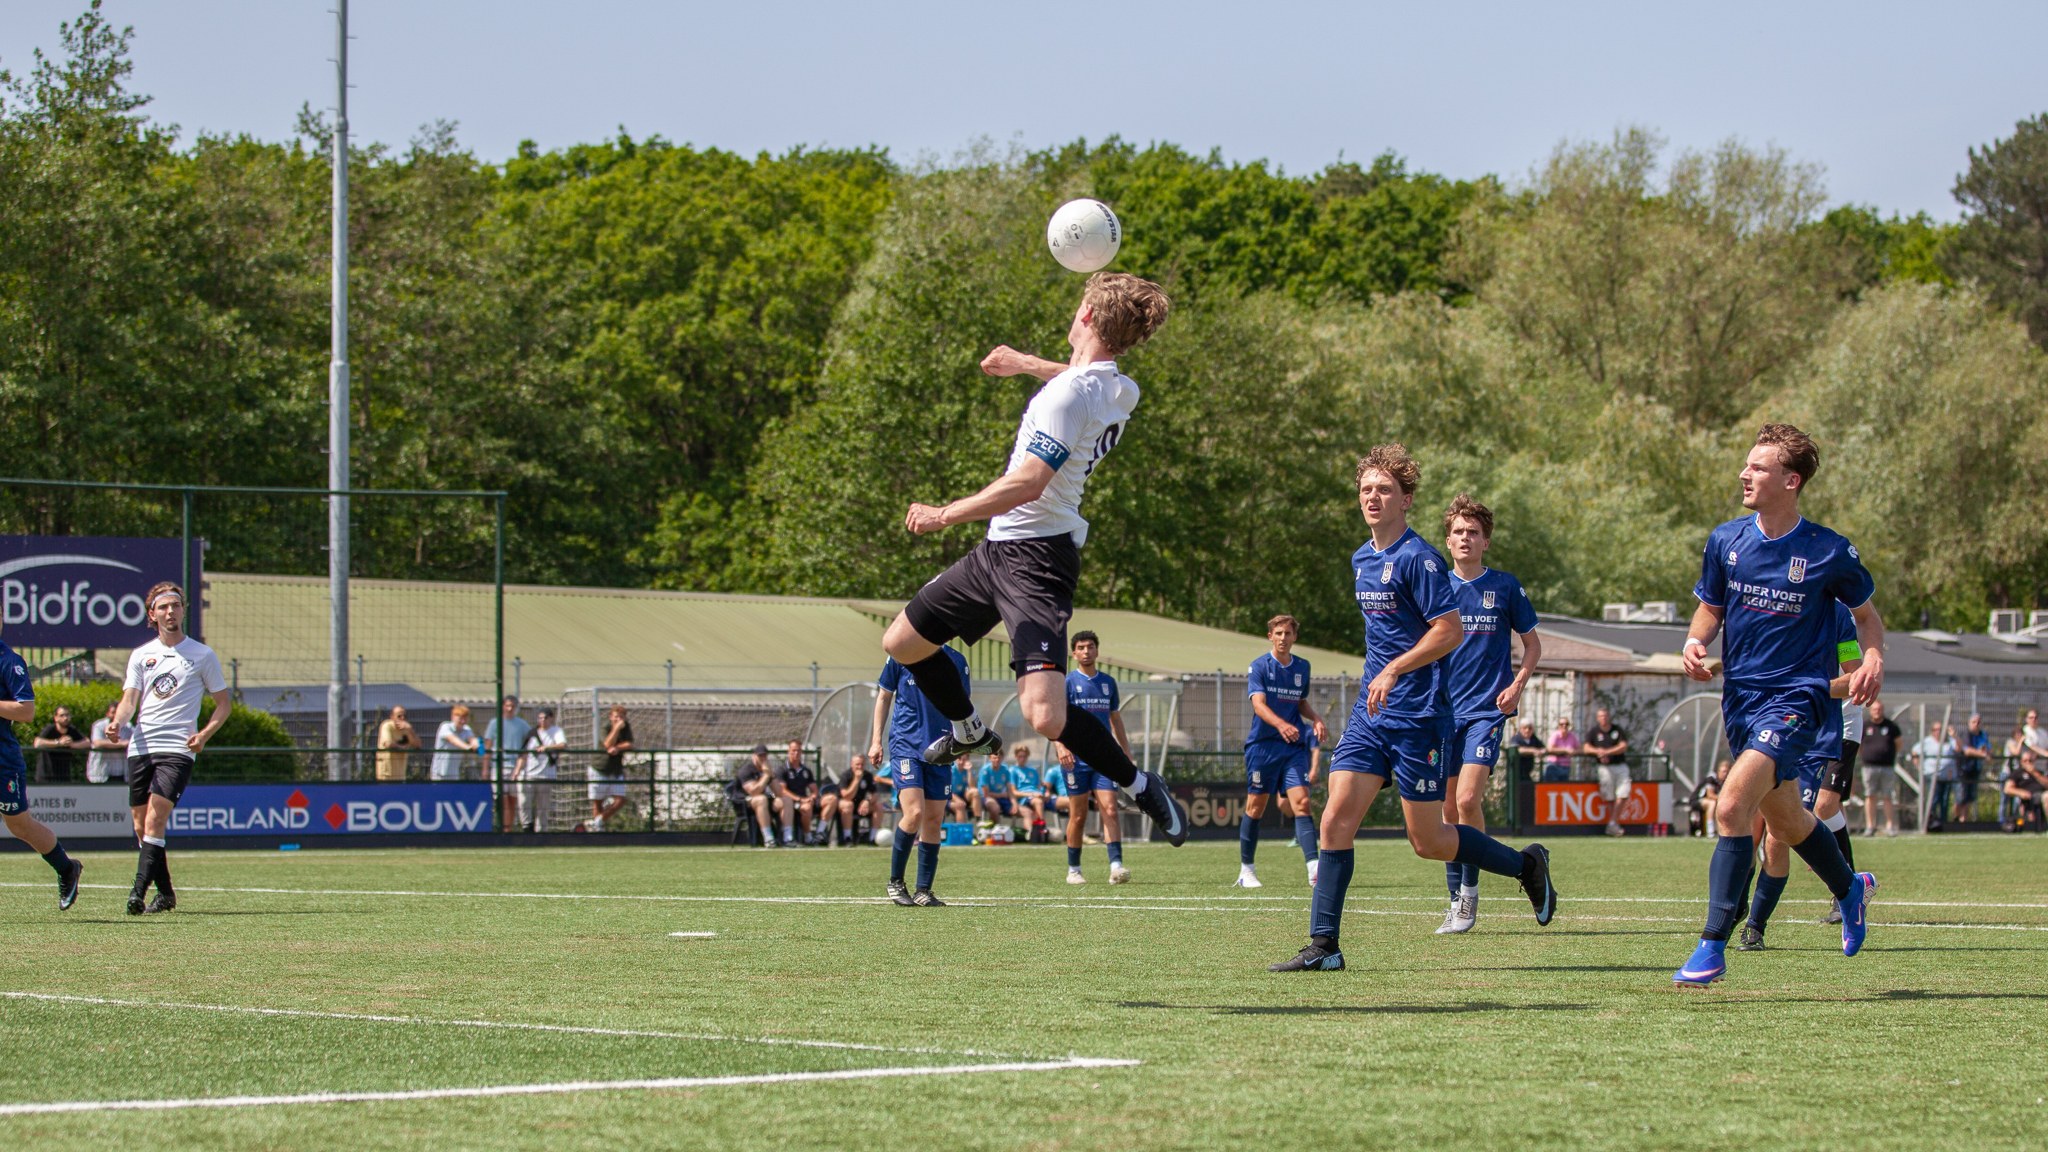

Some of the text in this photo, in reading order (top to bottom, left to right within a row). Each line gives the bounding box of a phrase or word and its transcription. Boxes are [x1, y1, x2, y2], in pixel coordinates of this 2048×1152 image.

[1033, 433, 1064, 459] SPECT
[1728, 580, 1805, 603] AN DER VOET
[3, 580, 146, 626] Bidfoo
[1743, 595, 1802, 613] KEUKENS
[1460, 615, 1498, 623] ER VOET
[1462, 623, 1497, 631] EUKENS
[1758, 729, 1772, 743] 9
[1475, 746, 1484, 758] 8
[1415, 779, 1426, 793] 4
[63, 798, 77, 808] BV
[1547, 791, 1607, 822] ING
[33, 812, 126, 823] OUDSDIENSTEN BV
[165, 807, 310, 830] EERLAND
[347, 801, 488, 832] BOUW
